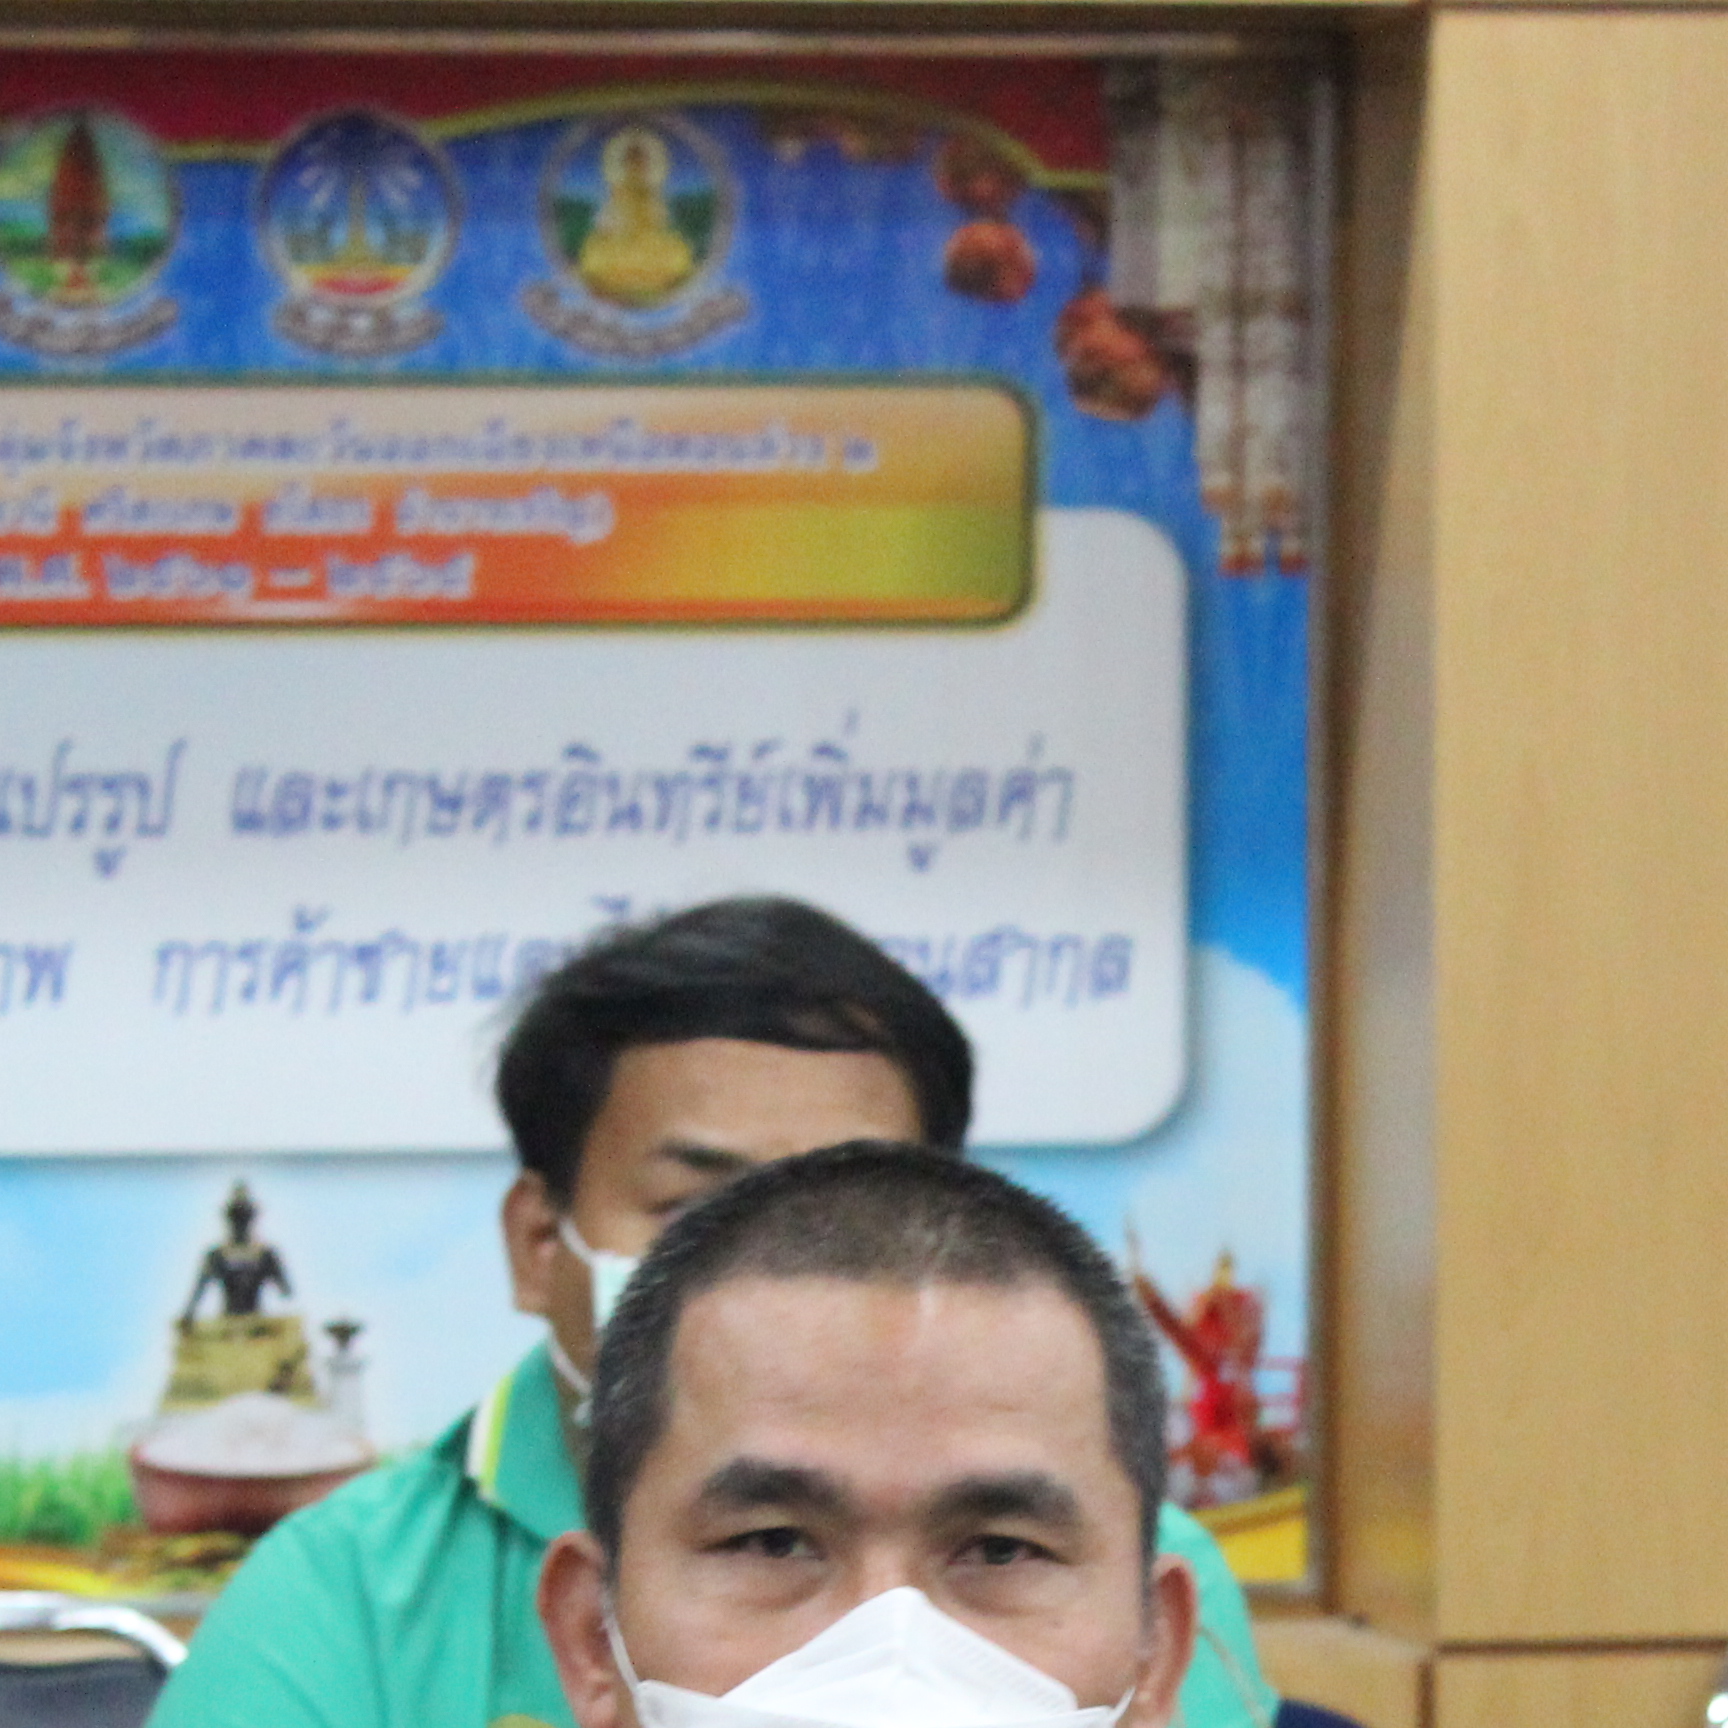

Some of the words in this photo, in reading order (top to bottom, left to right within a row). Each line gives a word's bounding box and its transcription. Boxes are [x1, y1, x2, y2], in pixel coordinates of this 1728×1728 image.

[229, 710, 1076, 871] และเกษตรอินทรีย์เพิ่มมูลค่า
